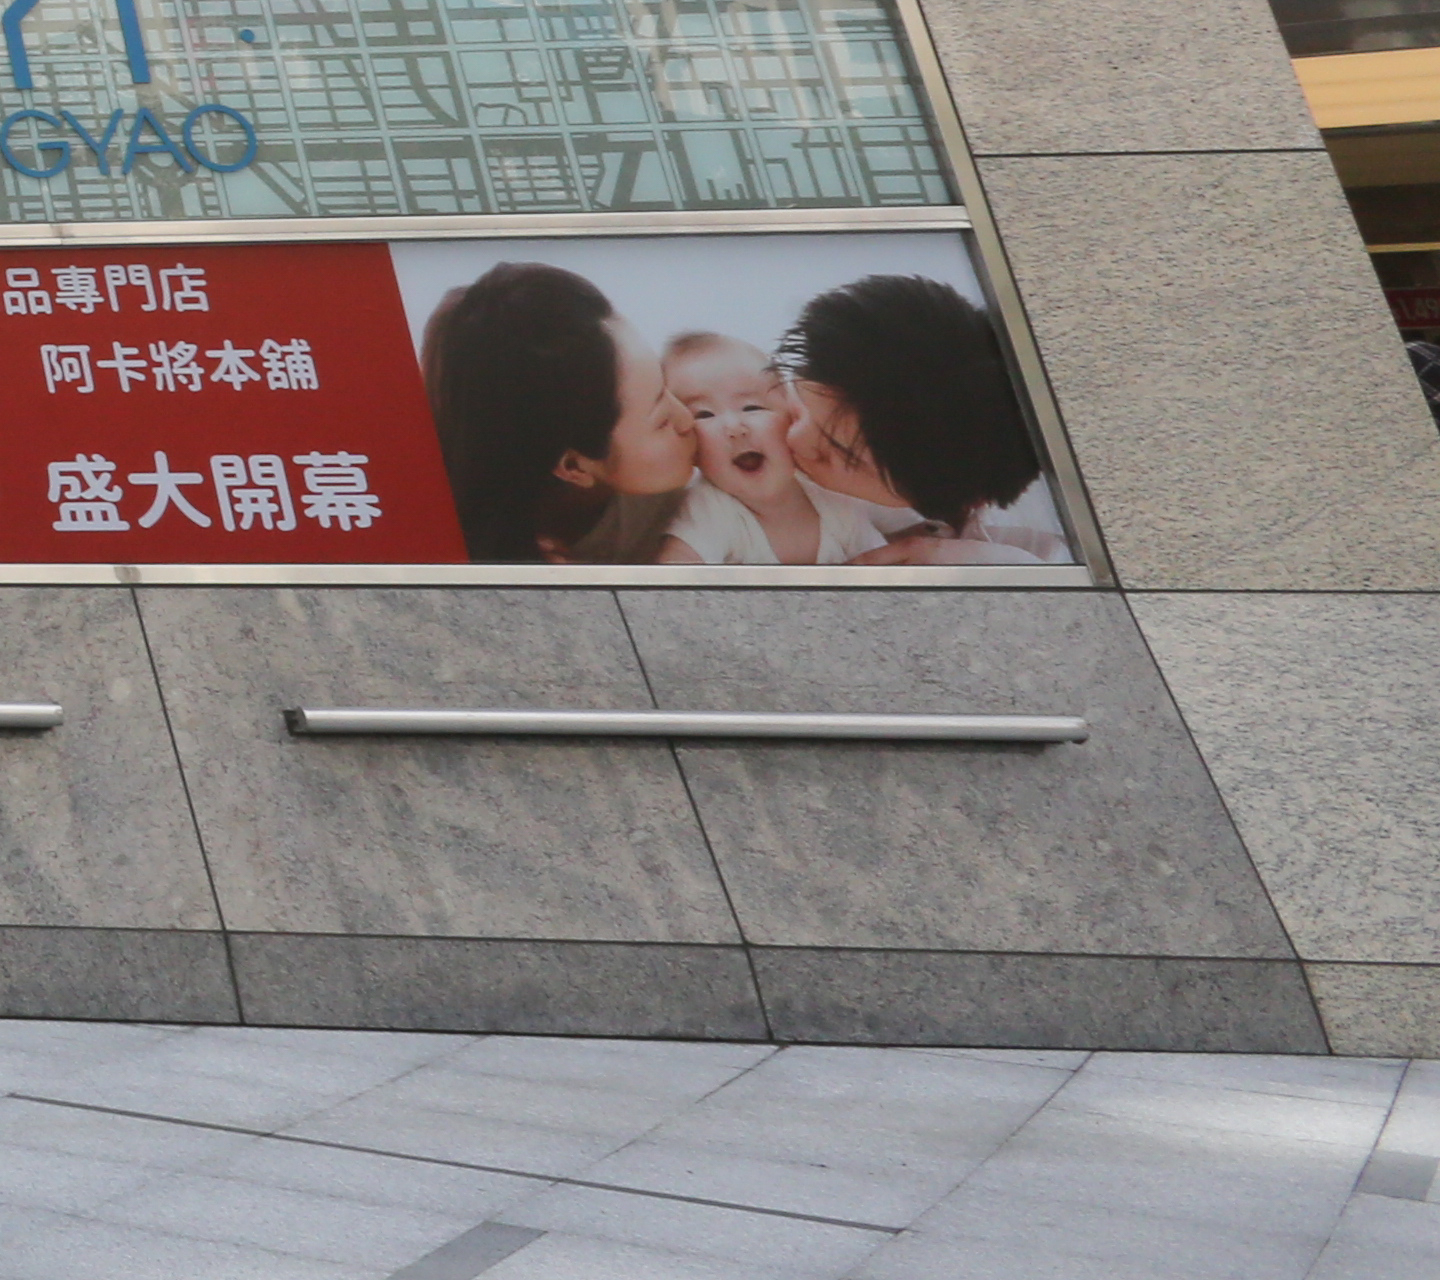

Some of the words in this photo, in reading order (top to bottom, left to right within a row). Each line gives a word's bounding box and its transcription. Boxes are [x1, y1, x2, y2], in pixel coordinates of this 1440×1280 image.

[39, 338, 320, 395] 阿卡將本舖
[48, 452, 382, 535] 盛大開幕
